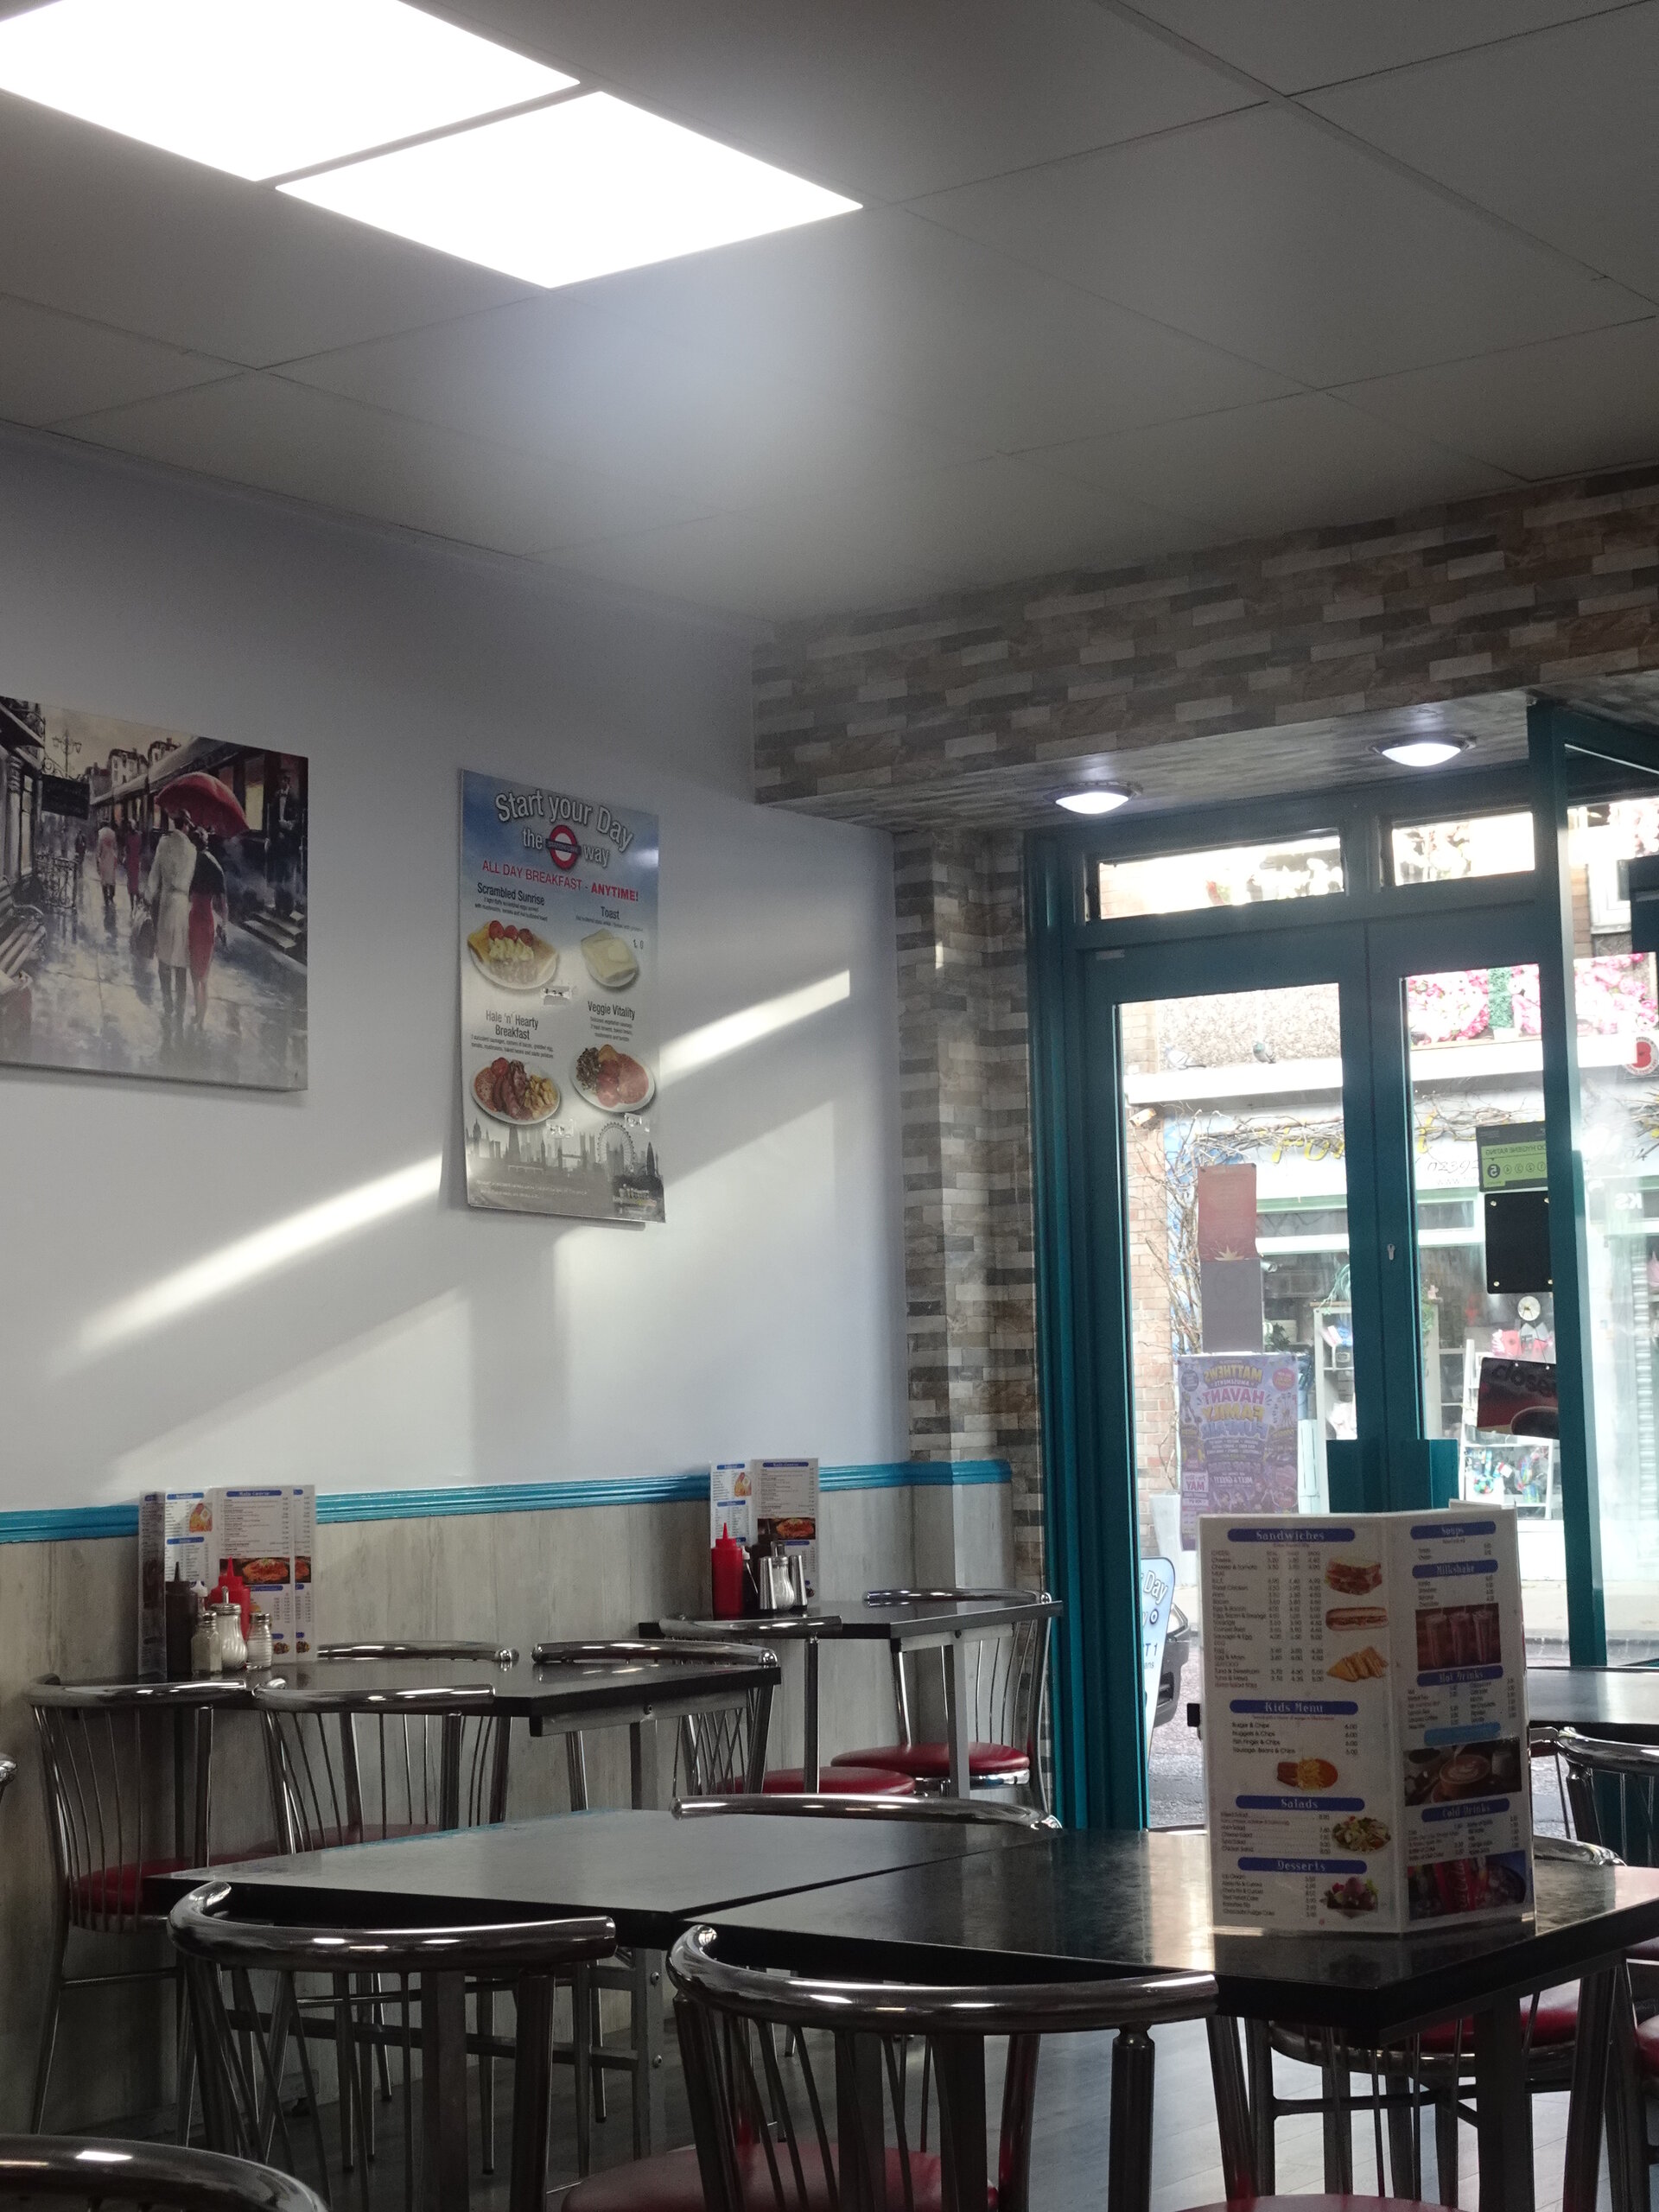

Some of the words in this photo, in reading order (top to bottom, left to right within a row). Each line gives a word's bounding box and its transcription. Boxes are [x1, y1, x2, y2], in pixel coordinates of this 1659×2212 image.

[495, 790, 544, 823] Start
[549, 796, 592, 826] your
[596, 806, 633, 853] Day
[523, 828, 543, 849] the
[583, 846, 610, 868] way
[482, 860, 499, 874] ALL
[503, 864, 523, 878] DAY
[525, 868, 582, 890] BREAKFAST
[591, 882, 639, 902] ANYTIME!
[477, 882, 516, 900] Scrambled
[518, 890, 545, 906] Sunrise
[601, 906, 620, 920] Toast
[486, 1009, 502, 1023] Hale
[515, 1015, 539, 1030] Hearty
[588, 1001, 611, 1016] Veggie
[613, 1005, 636, 1021] Vitality
[495, 1024, 531, 1040] Breakfast
[1255, 1531, 1325, 1541] Sandwiches
[1441, 1526, 1465, 1536] Soups
[1143, 1569, 1167, 1605] Day
[1264, 1701, 1291, 1713] Kids
[1295, 1702, 1324, 1713] Menu
[1281, 1798, 1319, 1809] Salads
[1277, 1859, 1326, 1872] Desserts
